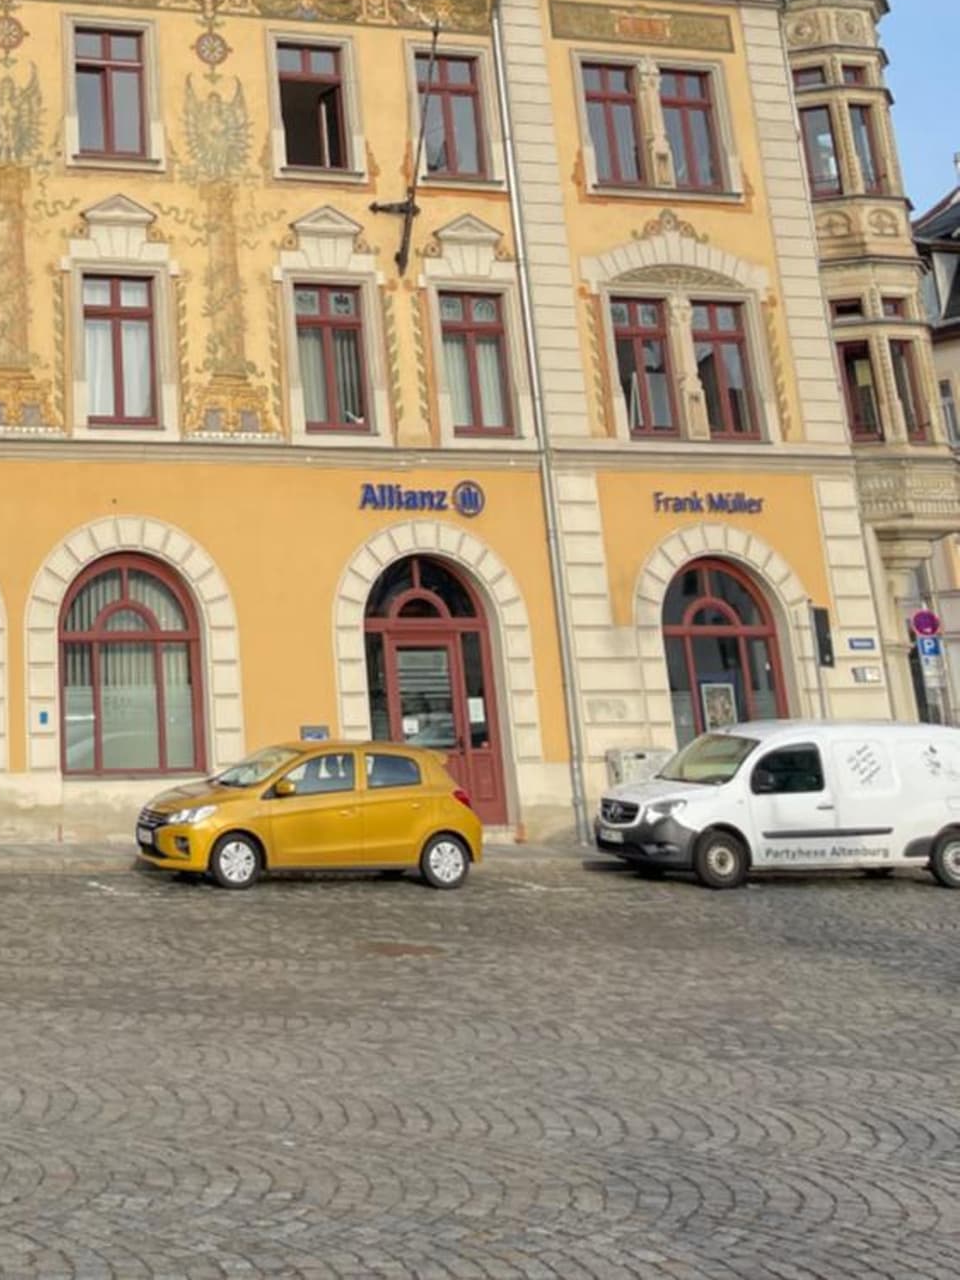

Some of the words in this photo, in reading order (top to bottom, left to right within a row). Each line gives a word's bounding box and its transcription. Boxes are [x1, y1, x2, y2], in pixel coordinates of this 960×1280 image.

[358, 483, 449, 511] Allianz
[653, 490, 704, 513] Frank
[706, 491, 764, 514] Müller
[923, 639, 935, 654] P
[830, 845, 889, 859] Altenburg
